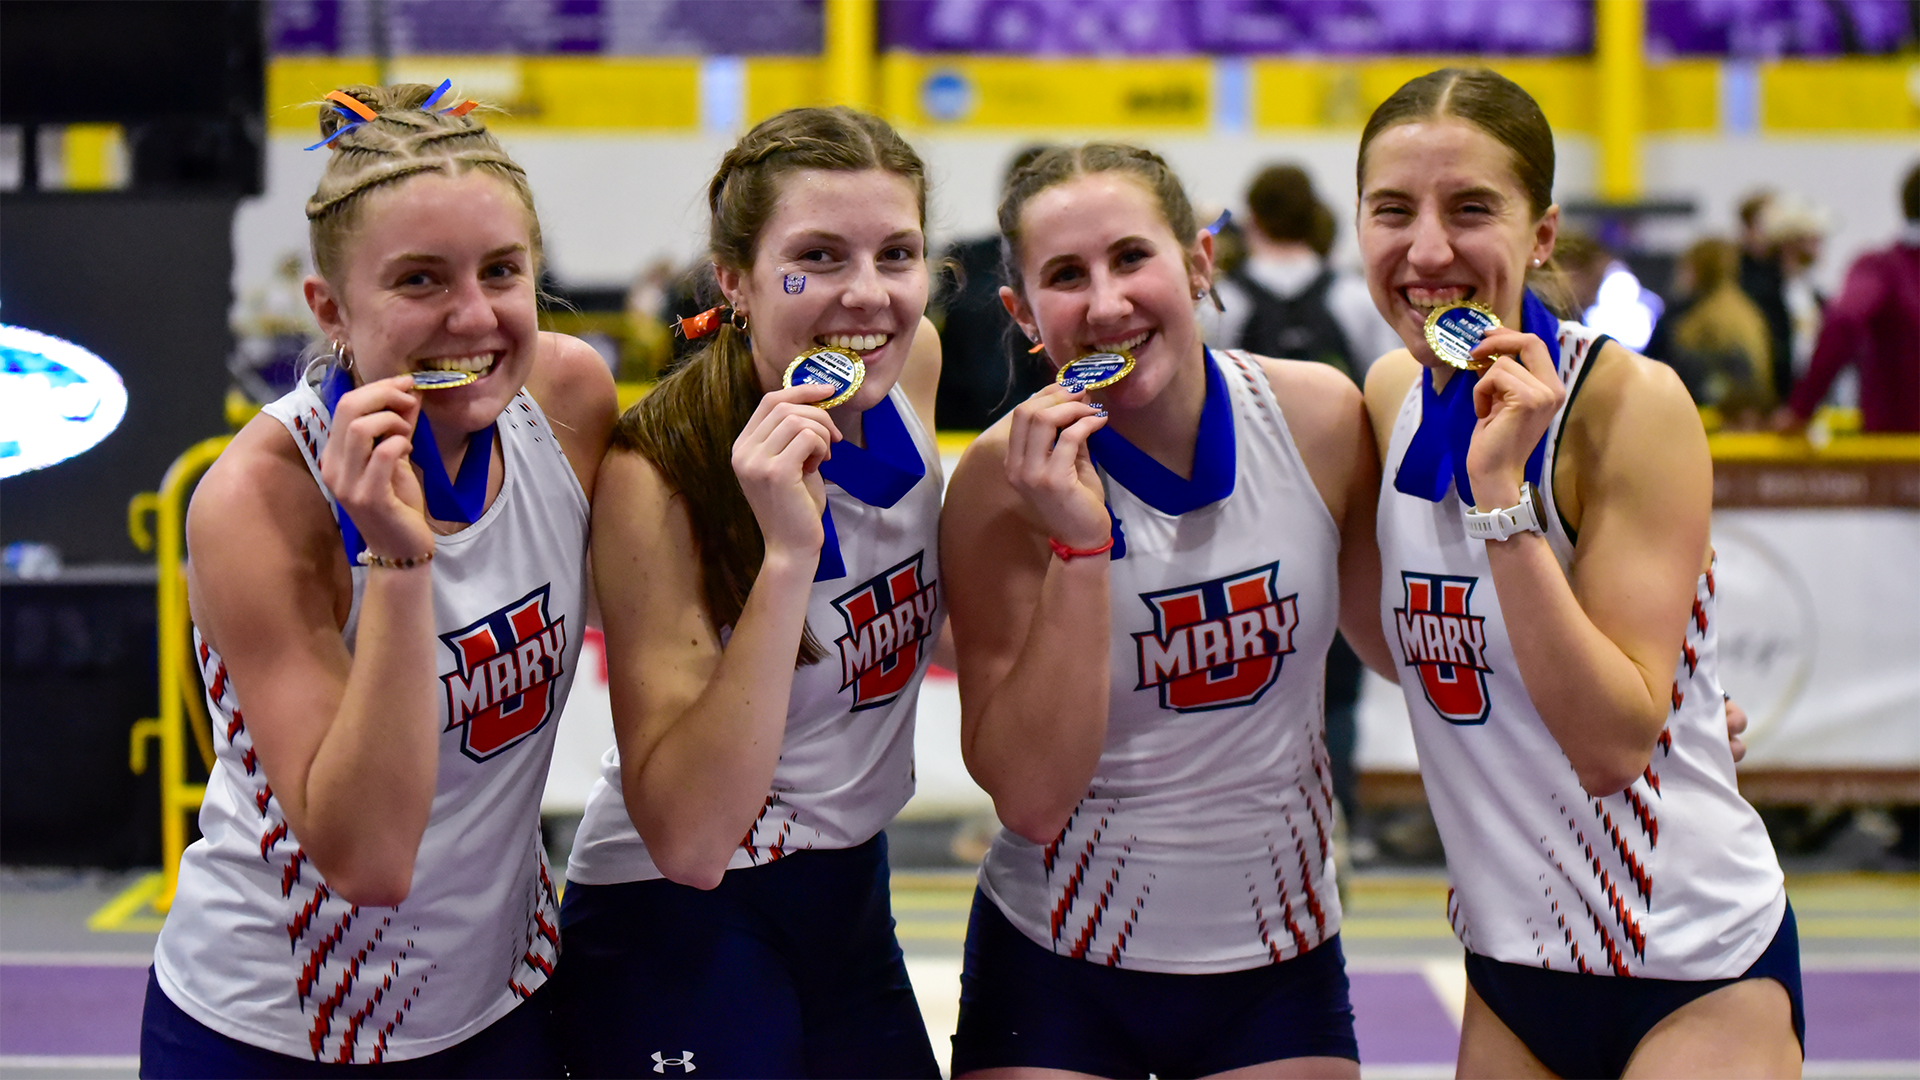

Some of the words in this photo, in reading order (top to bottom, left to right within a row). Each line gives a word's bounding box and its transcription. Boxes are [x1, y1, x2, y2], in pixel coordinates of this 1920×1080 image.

[447, 619, 565, 727] MARY
[841, 584, 936, 687] MARY
[1140, 598, 1297, 687] MARY
[1397, 611, 1487, 670] MARY
